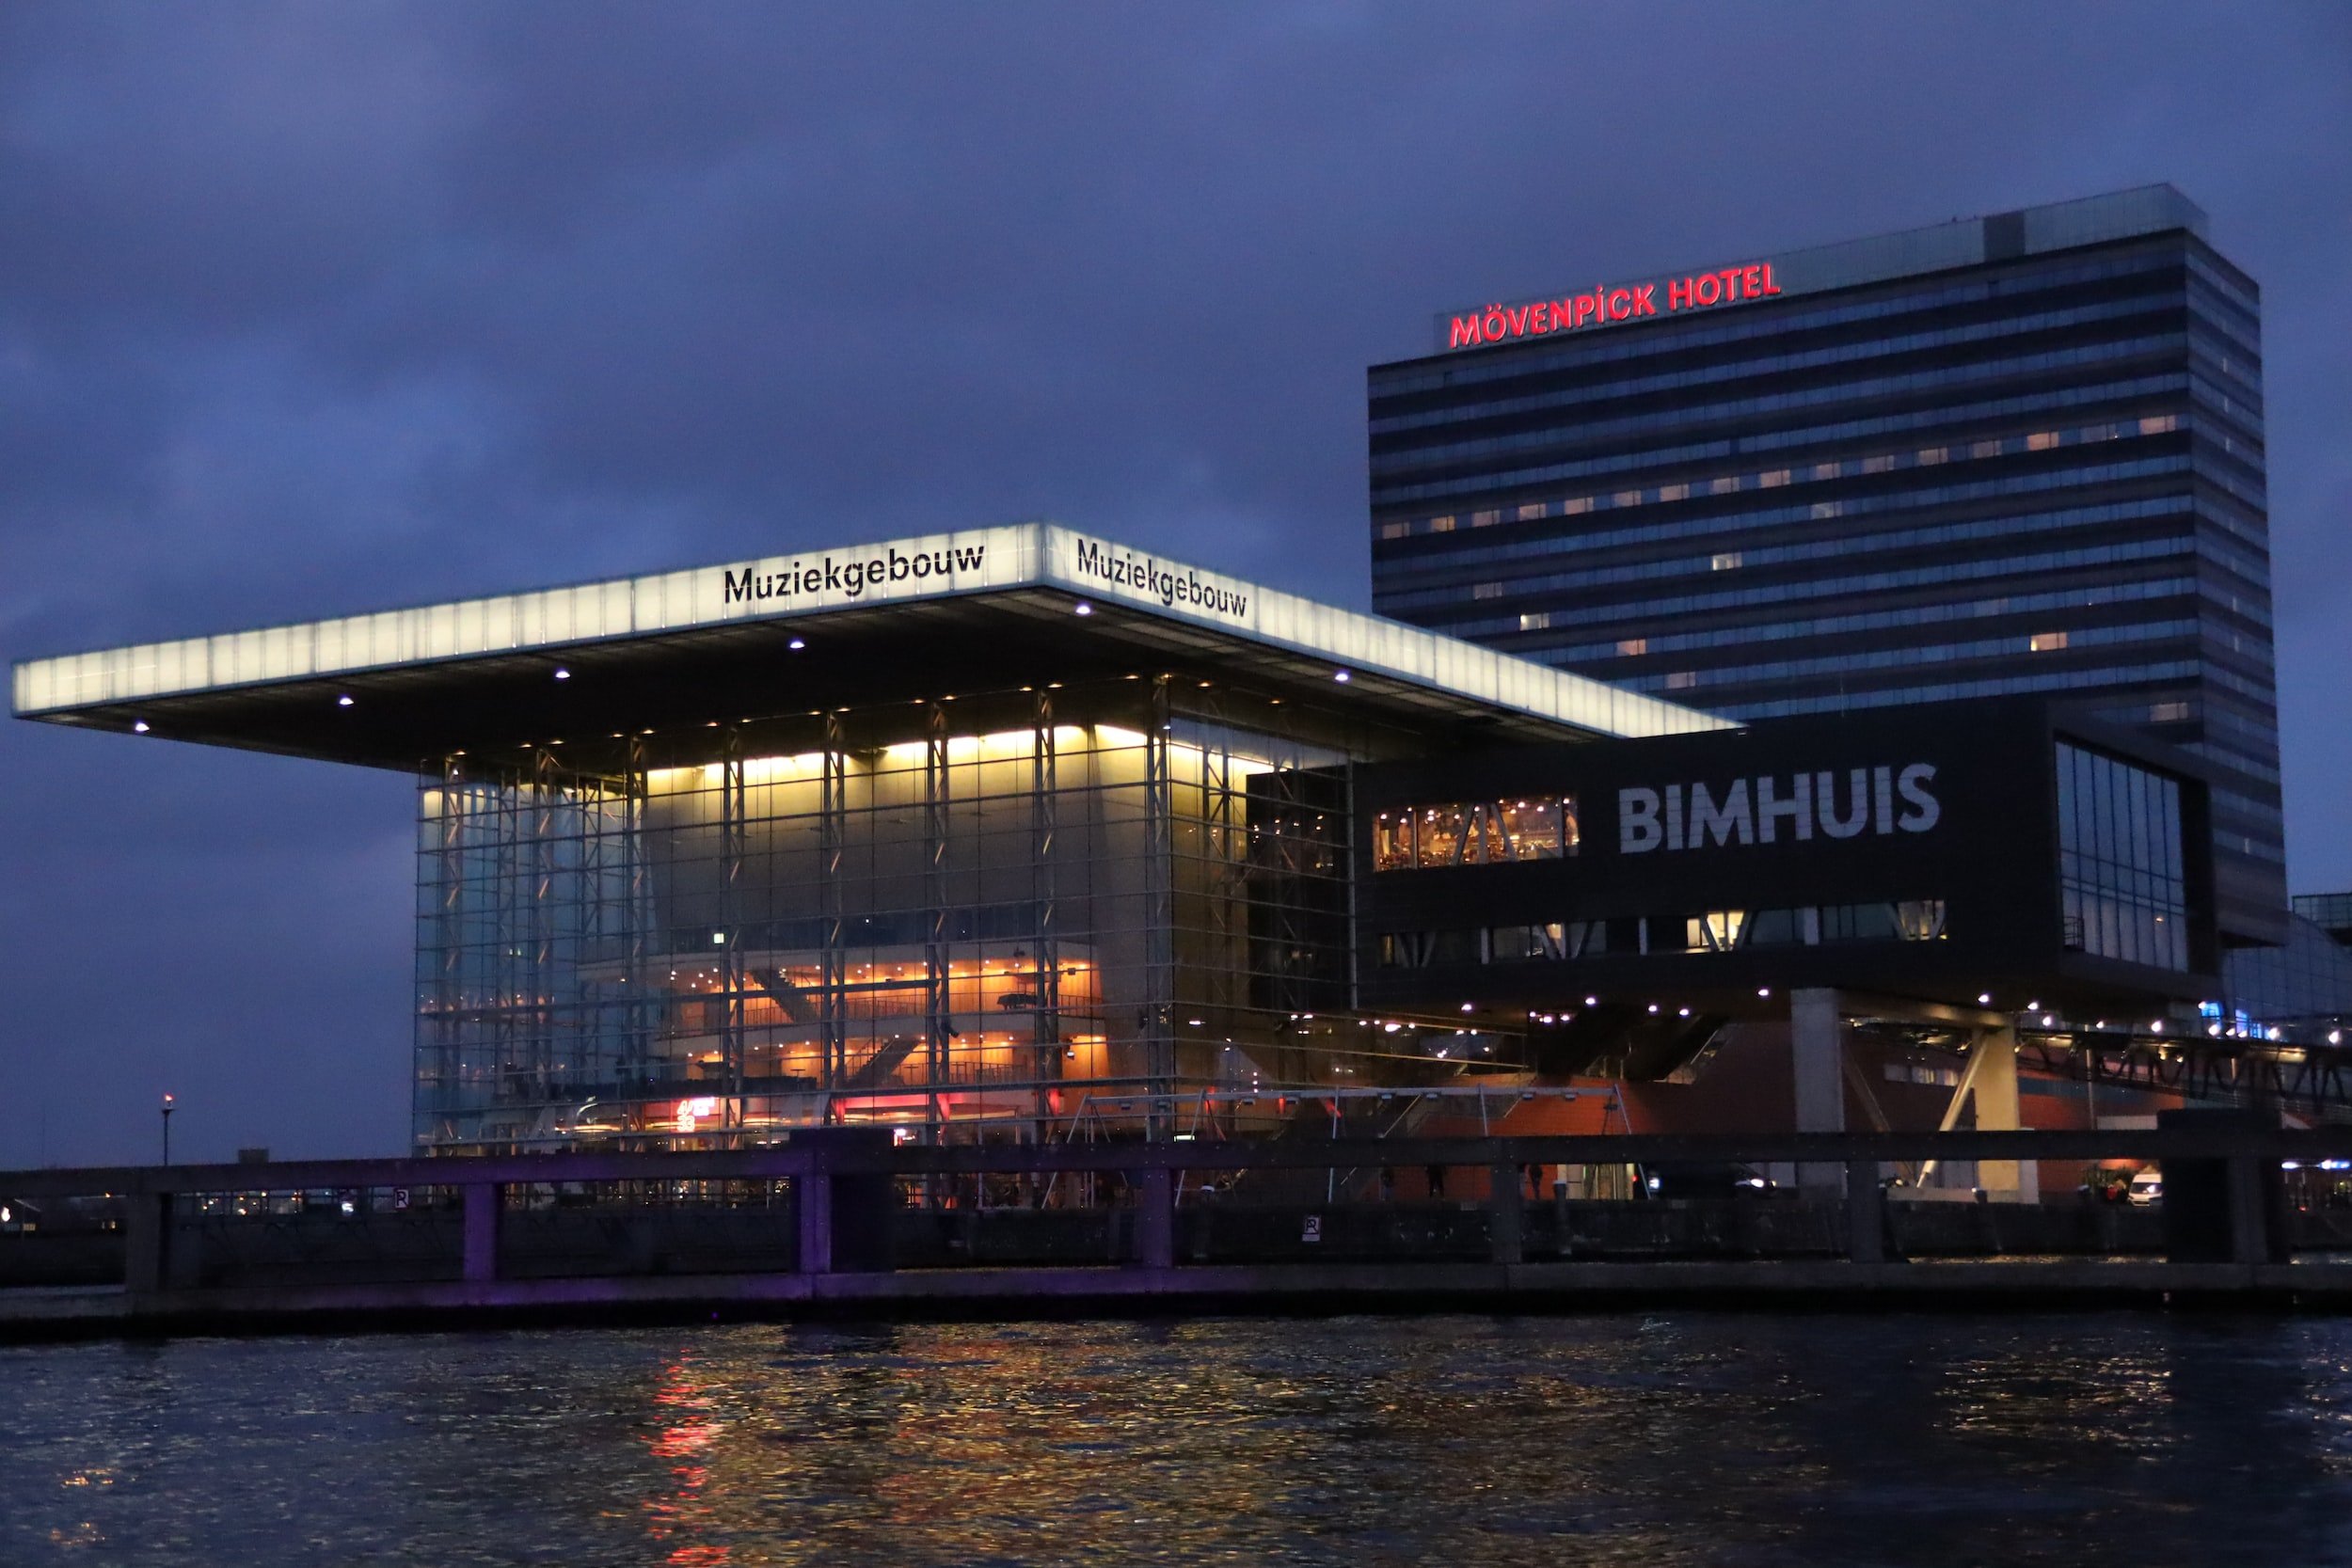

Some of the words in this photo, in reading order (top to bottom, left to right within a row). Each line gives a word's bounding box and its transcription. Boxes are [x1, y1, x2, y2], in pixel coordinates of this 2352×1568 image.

[1668, 262, 1781, 311] HOTEL
[724, 546, 985, 603] Muziekgebouw
[1077, 539, 1247, 617] Muziekgebouw
[1618, 763, 1941, 854] BIMHUIS
